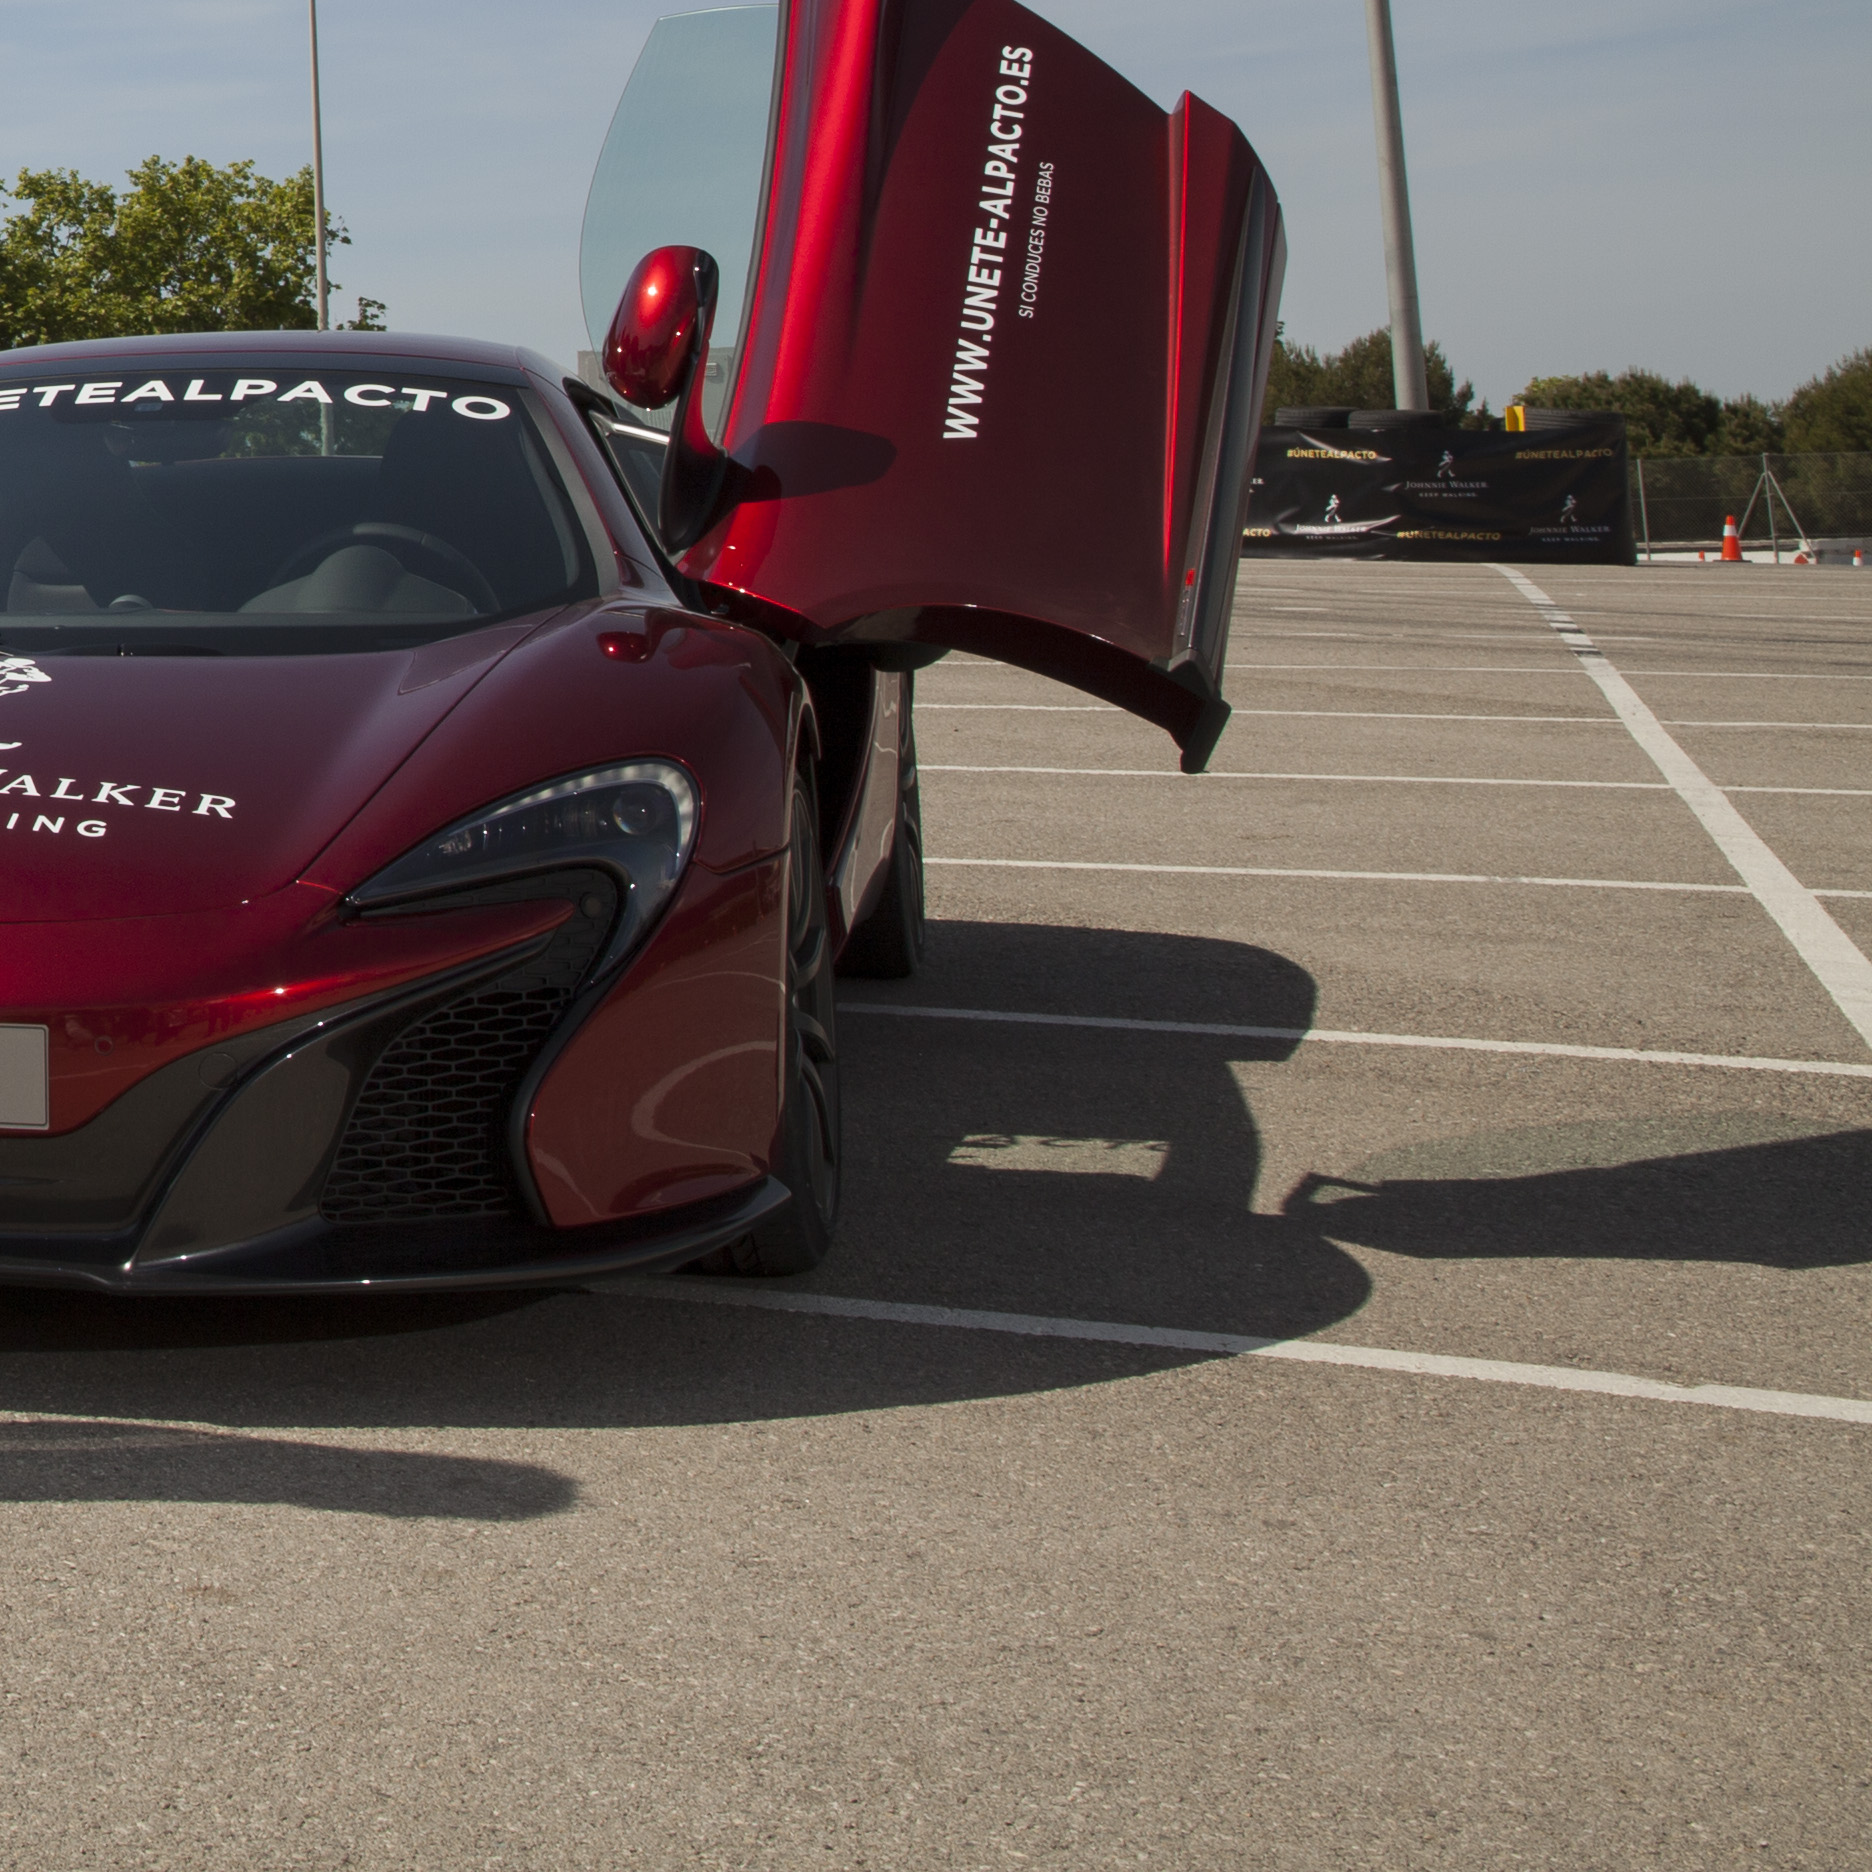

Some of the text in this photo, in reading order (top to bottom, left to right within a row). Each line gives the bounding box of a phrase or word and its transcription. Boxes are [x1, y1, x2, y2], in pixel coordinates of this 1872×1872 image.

[943, 45, 1033, 439] WWW.UNETE-ALPACTO.ES
[1018, 161, 1054, 319] SI CONDUCES NO BEBAS
